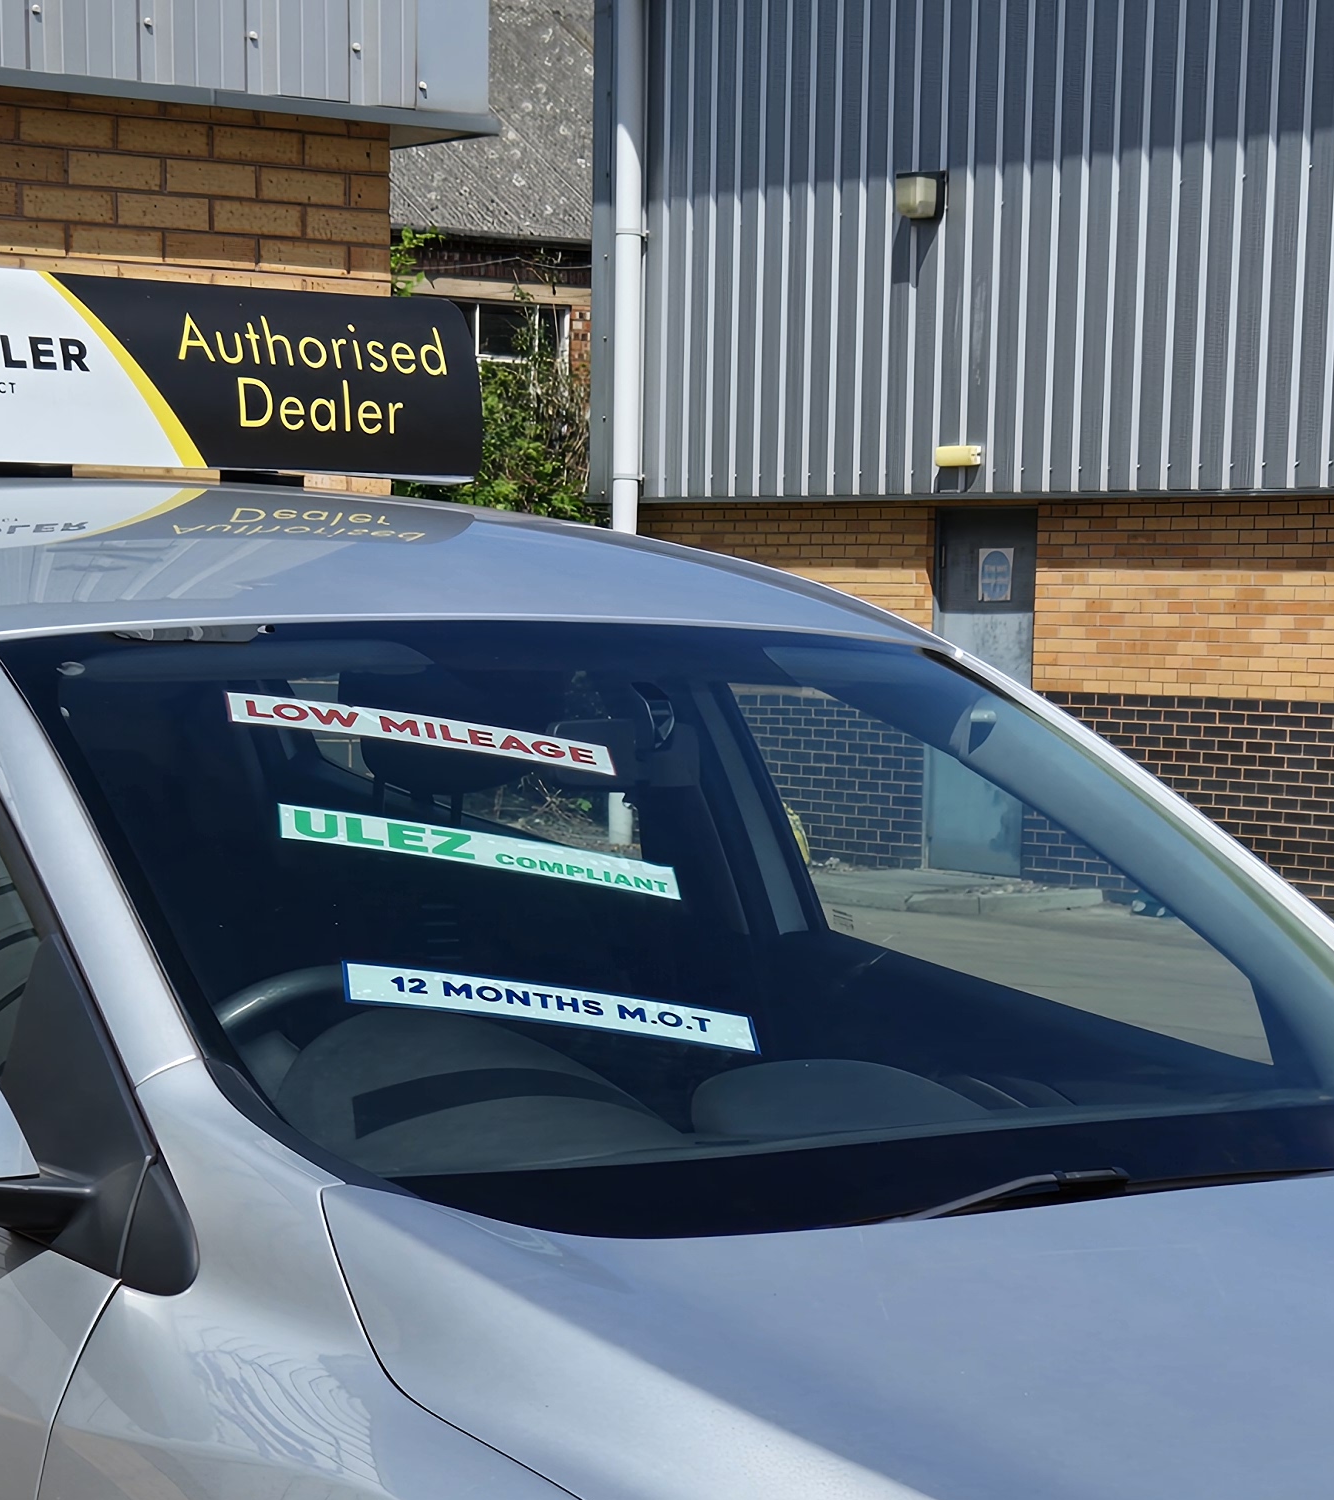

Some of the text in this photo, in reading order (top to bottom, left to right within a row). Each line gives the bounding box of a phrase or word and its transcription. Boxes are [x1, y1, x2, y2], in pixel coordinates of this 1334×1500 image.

[178, 312, 448, 377] Authorised
[238, 377, 404, 435] Dealer
[246, 700, 597, 766] LOW MILEAGE
[293, 809, 669, 894] ULEZ COMPLIANT
[390, 976, 712, 1034] 12 MONTHS M.O.T
